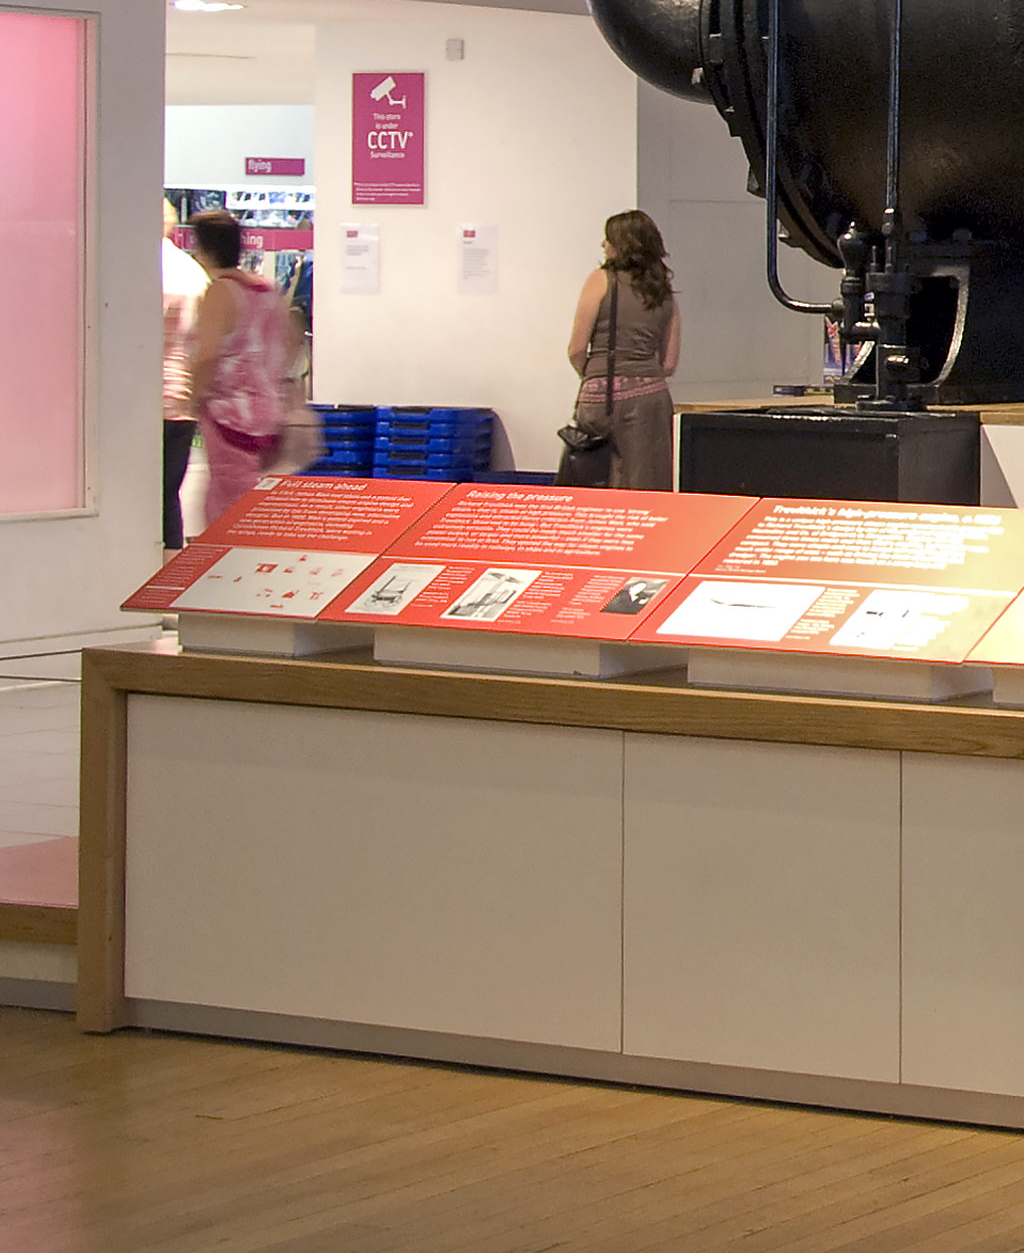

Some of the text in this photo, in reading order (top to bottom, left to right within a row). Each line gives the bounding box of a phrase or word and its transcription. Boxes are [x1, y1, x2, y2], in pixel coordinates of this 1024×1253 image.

[367, 131, 409, 149] CCTV
[466, 490, 574, 503] Raising the pressure
